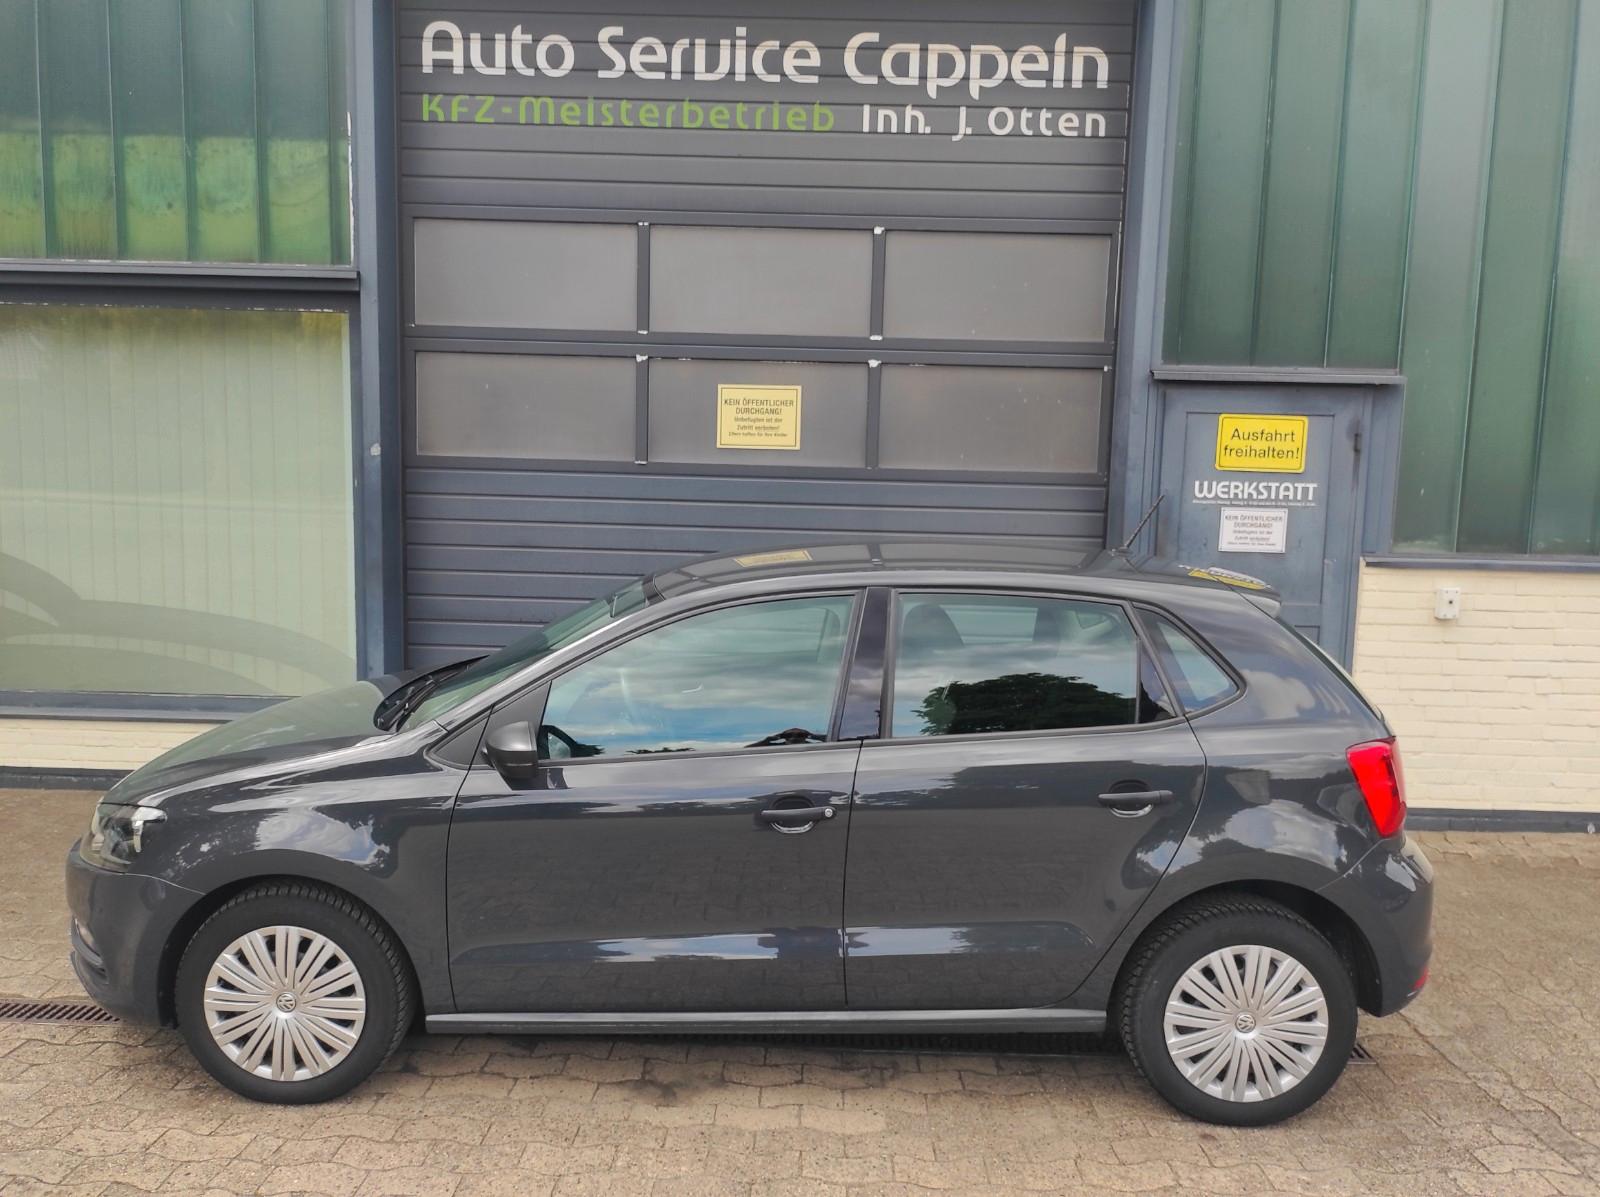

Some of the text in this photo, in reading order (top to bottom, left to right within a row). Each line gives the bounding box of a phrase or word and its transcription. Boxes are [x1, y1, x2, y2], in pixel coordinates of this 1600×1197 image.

[422, 20, 1109, 100] Auto Service Cappeln
[862, 103, 931, 134] Inh.
[952, 106, 973, 142] J.
[987, 106, 1106, 138] Otten
[742, 398, 794, 407] ÖFFENTLICHER
[735, 407, 782, 415] DURCHGANG!
[1231, 428, 1296, 443] Ausfahrt
[1224, 446, 1300, 460] freihalten!
[1194, 480, 1318, 501] WERKSTATT
